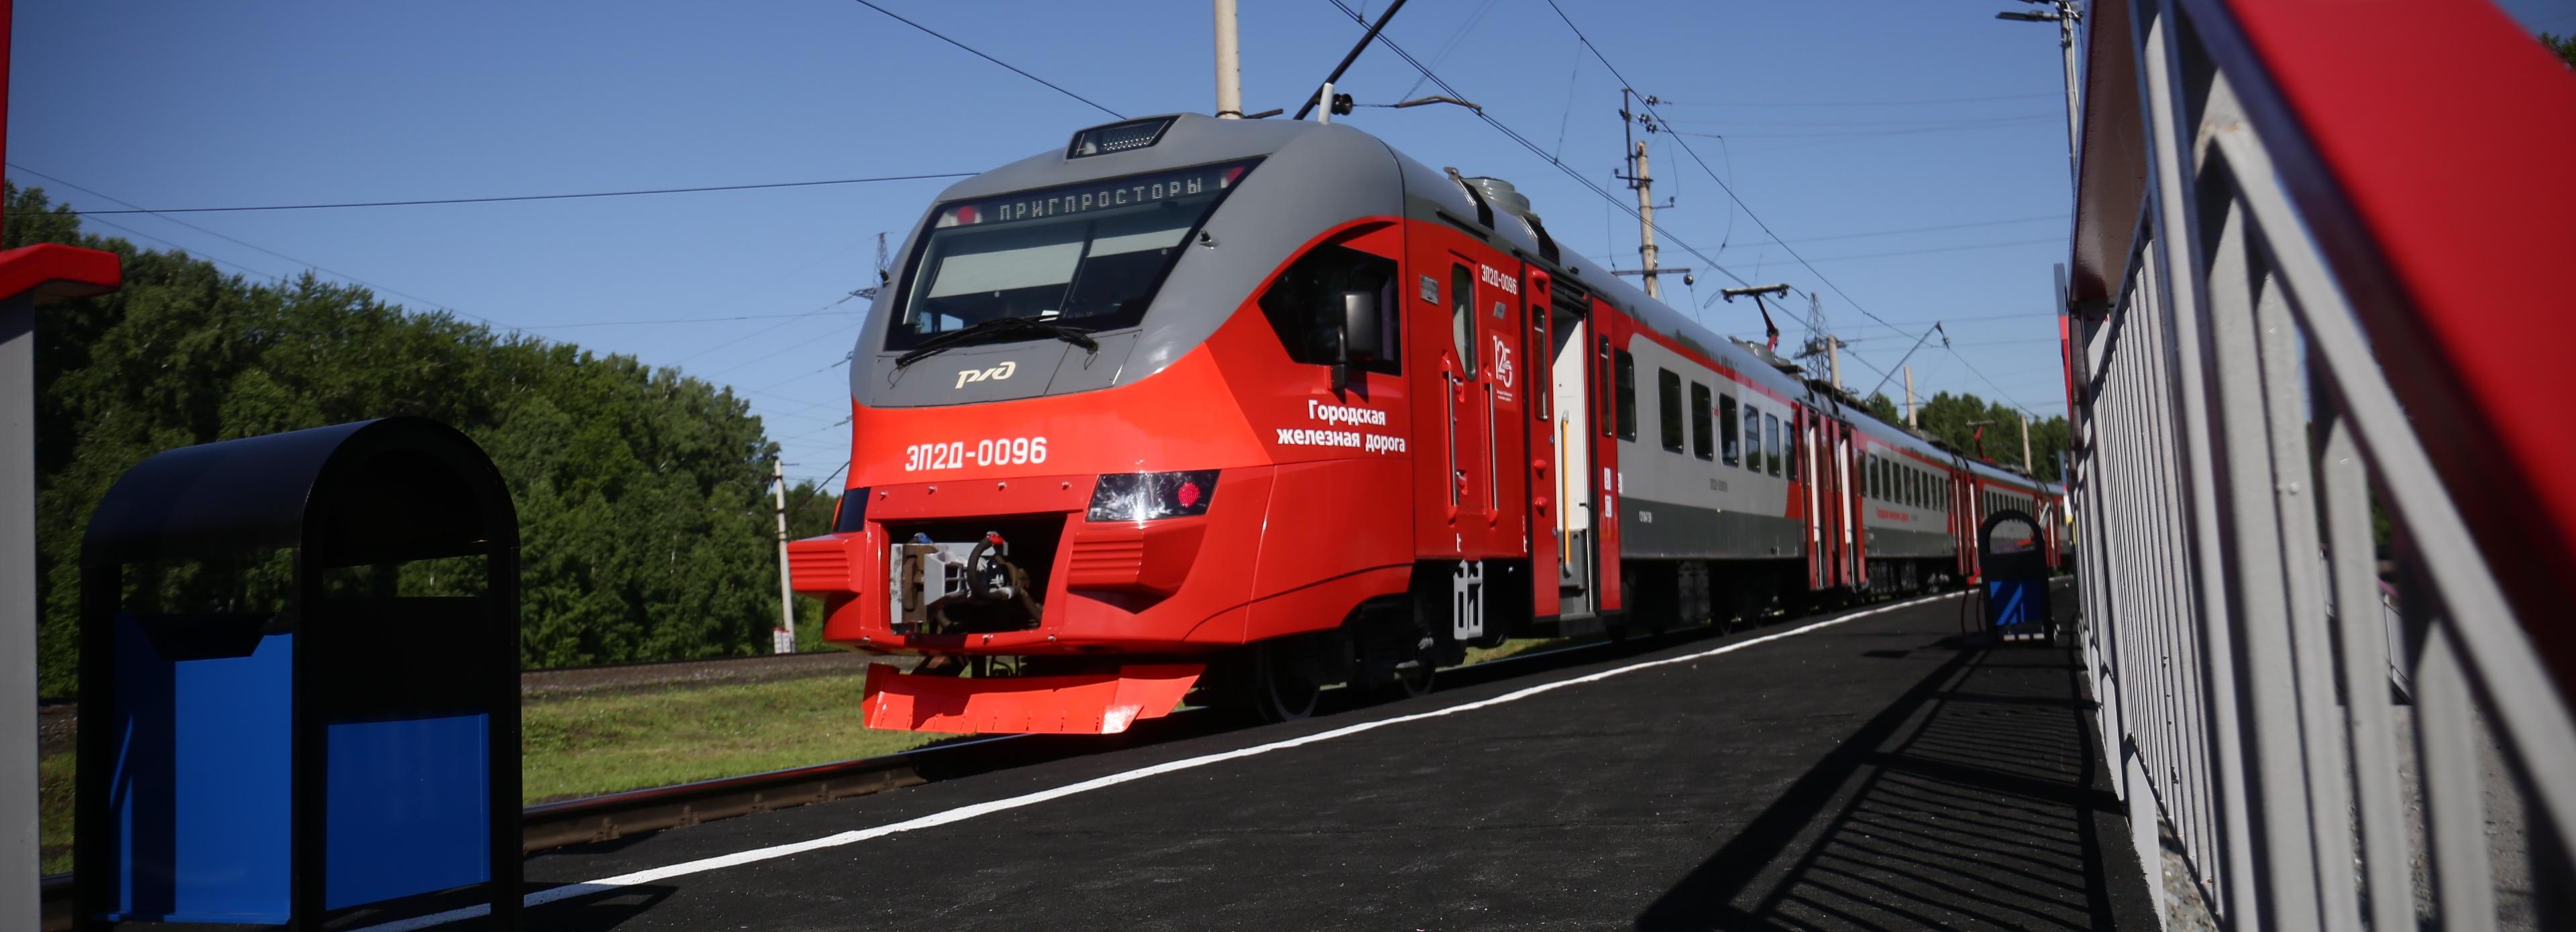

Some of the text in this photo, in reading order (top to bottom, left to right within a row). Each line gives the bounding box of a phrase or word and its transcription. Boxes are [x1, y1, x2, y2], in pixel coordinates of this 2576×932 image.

[1000, 177, 1201, 221] ПРИГПРОСТОРЫ
[1481, 264, 1517, 295] ЭП2Д-0096
[1493, 335, 1513, 388] 125
[1308, 400, 1386, 426] Городская
[905, 436, 1047, 471] ЭП2Д-0096
[1276, 428, 1406, 455] железная дорога
